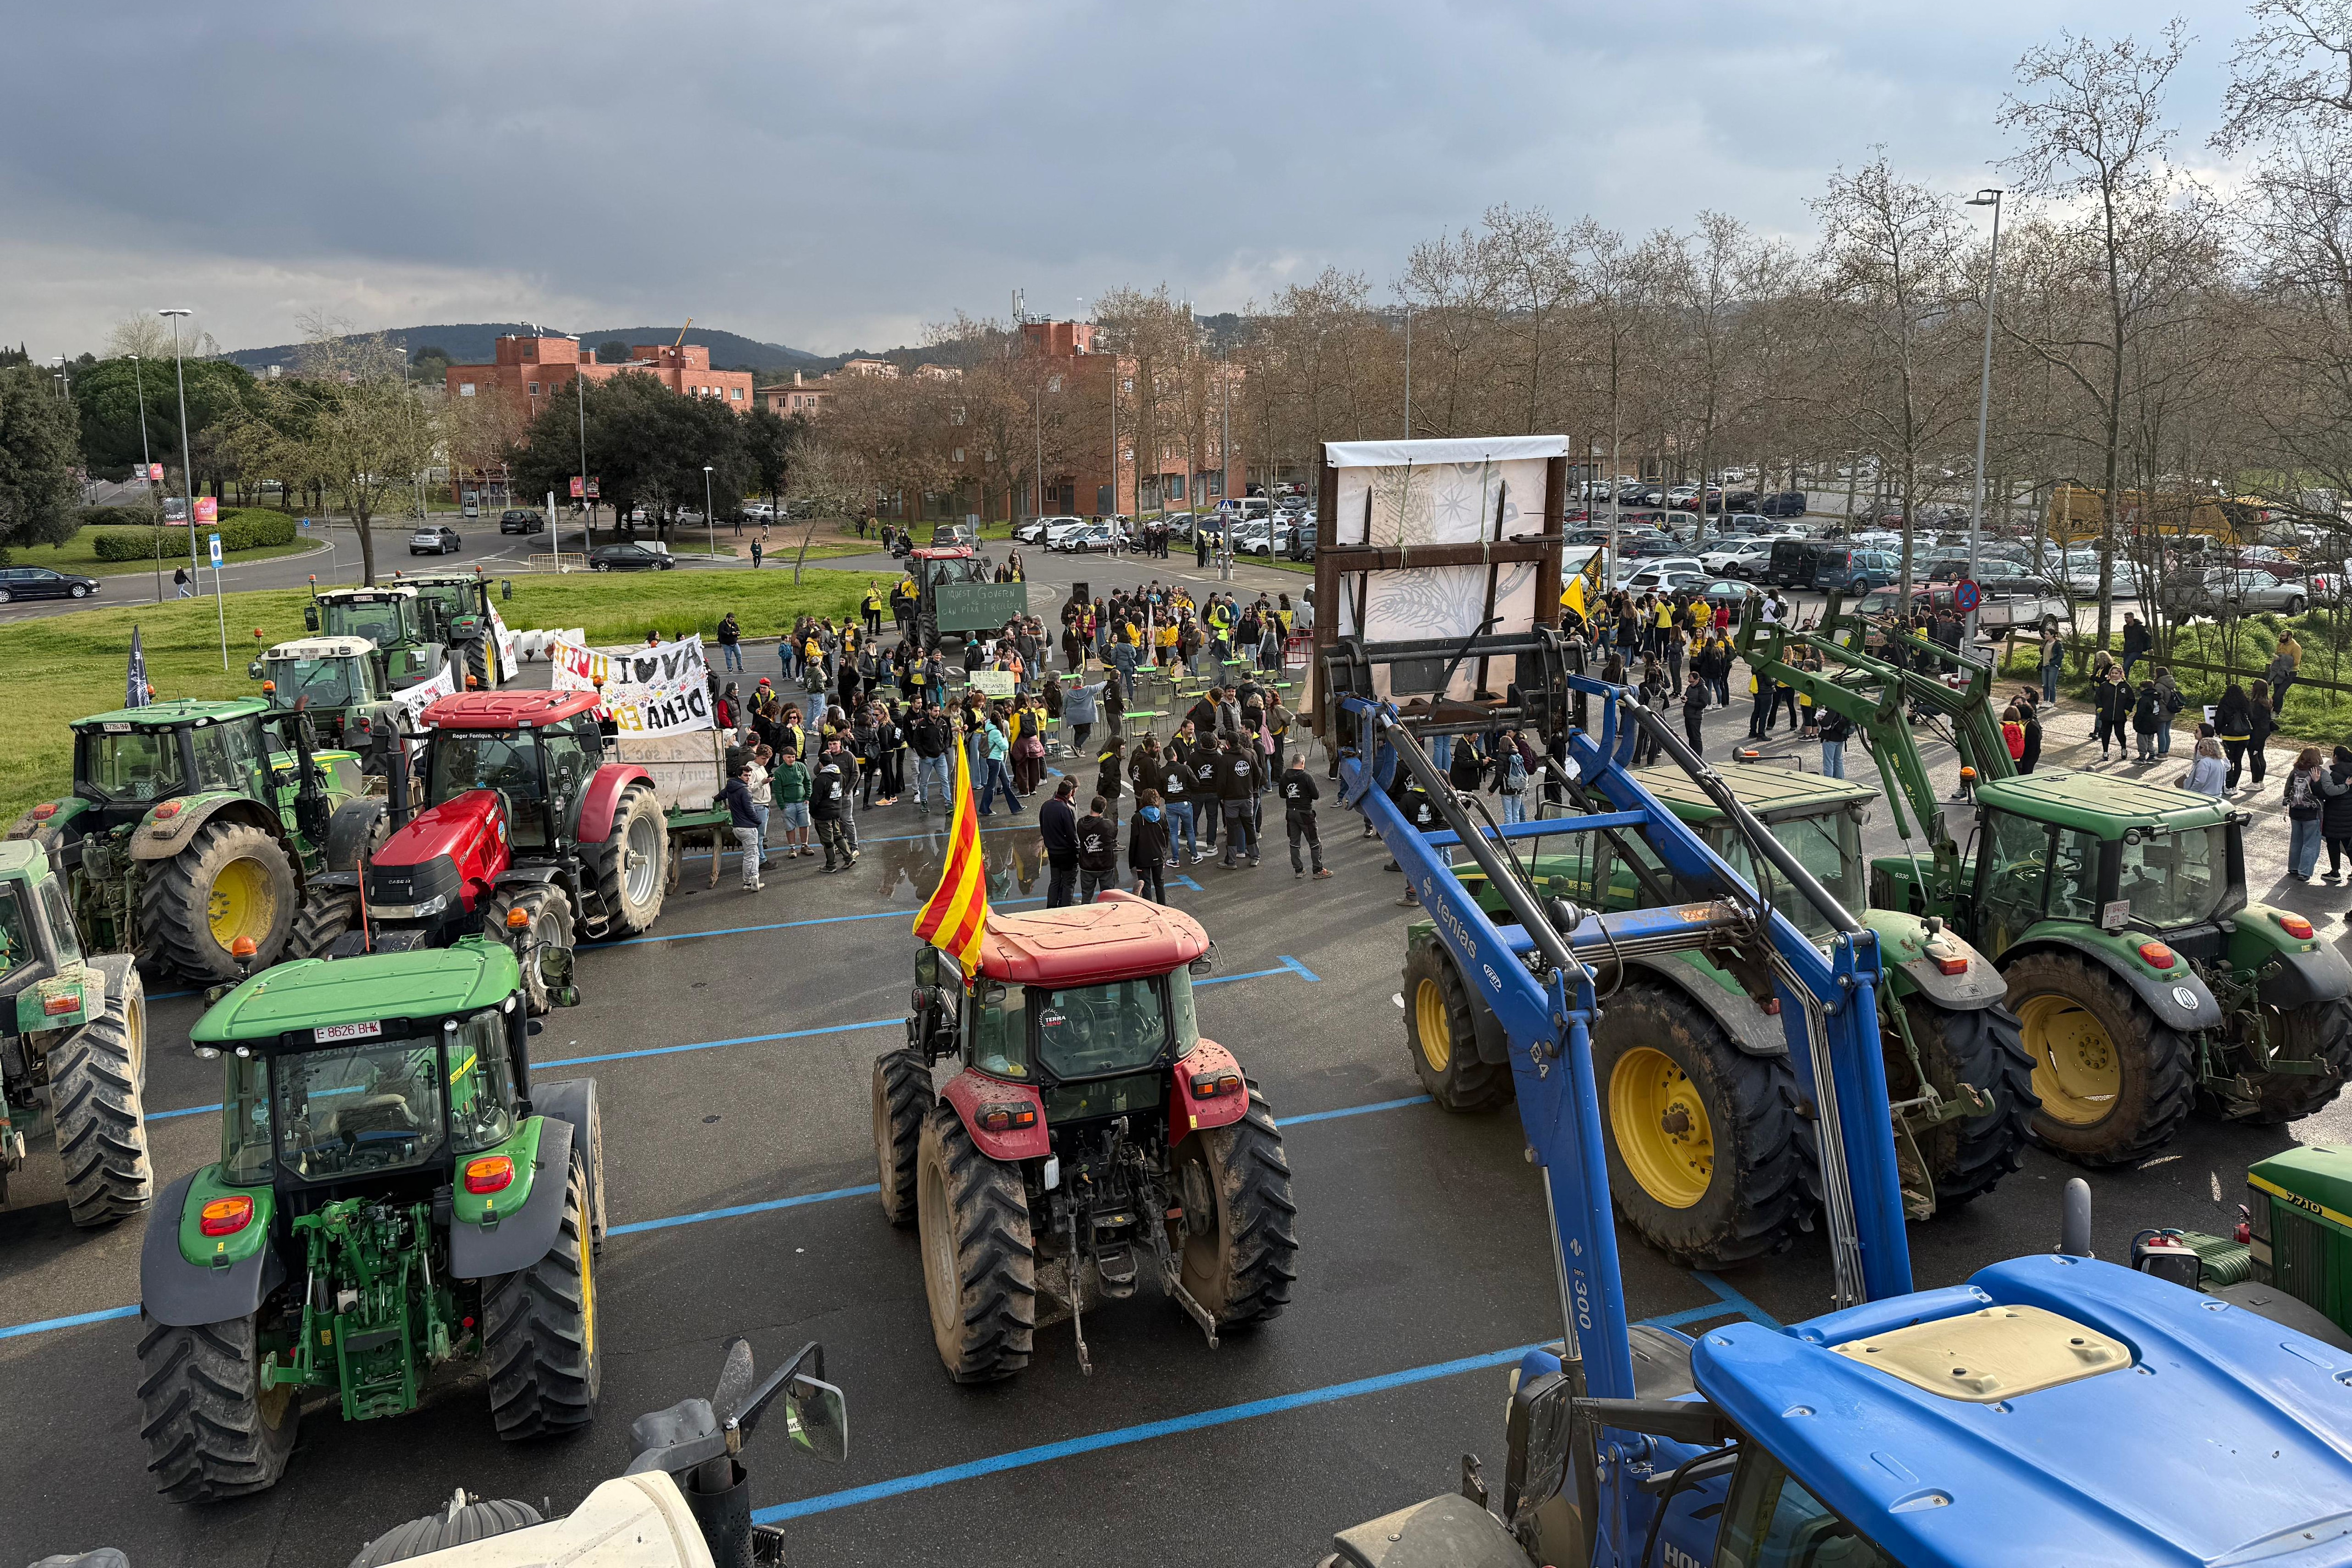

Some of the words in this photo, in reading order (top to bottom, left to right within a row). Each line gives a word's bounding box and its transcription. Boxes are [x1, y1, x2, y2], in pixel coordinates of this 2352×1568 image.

[946, 590, 971, 600] AQUEST
[2113, 902, 2129, 913] 8499
[2177, 987, 2196, 1009] 40
[316, 1028, 324, 1039] E
[328, 1025, 355, 1037] 8626
[2287, 1191, 2321, 1215] 7710
[1575, 1280, 1592, 1330] 300
